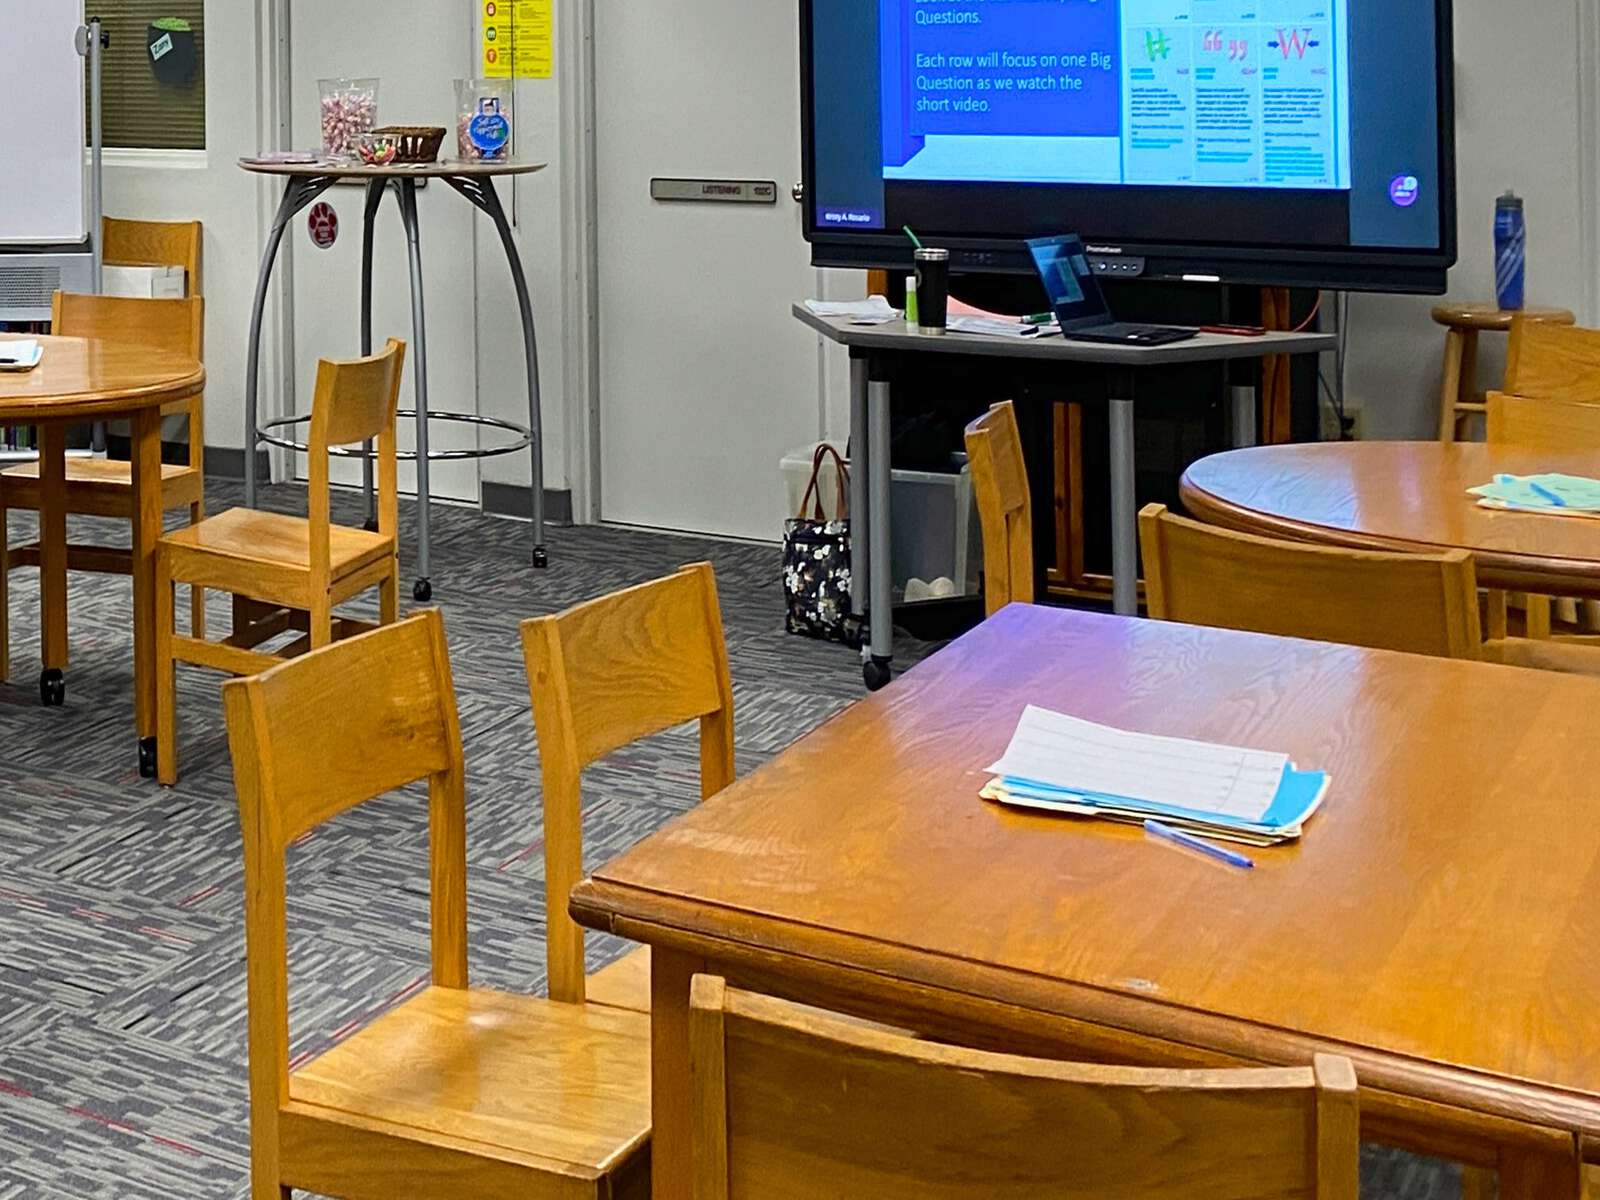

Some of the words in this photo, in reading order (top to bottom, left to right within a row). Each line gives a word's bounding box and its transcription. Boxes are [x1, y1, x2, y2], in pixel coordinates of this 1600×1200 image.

[915, 9, 982, 25] Questions.
[916, 53, 945, 68] Each
[949, 56, 973, 67] row
[976, 52, 999, 67] will
[1002, 51, 1037, 67] focus
[1040, 56, 1057, 67] on
[1061, 55, 1087, 67] one
[1090, 52, 1112, 70] Big
[916, 75, 973, 91] Question
[977, 78, 990, 89] as
[994, 78, 1013, 90] we
[1017, 75, 1056, 90] watch
[1060, 75, 1082, 90] the
[916, 96, 949, 111] short
[952, 96, 991, 112] video.
